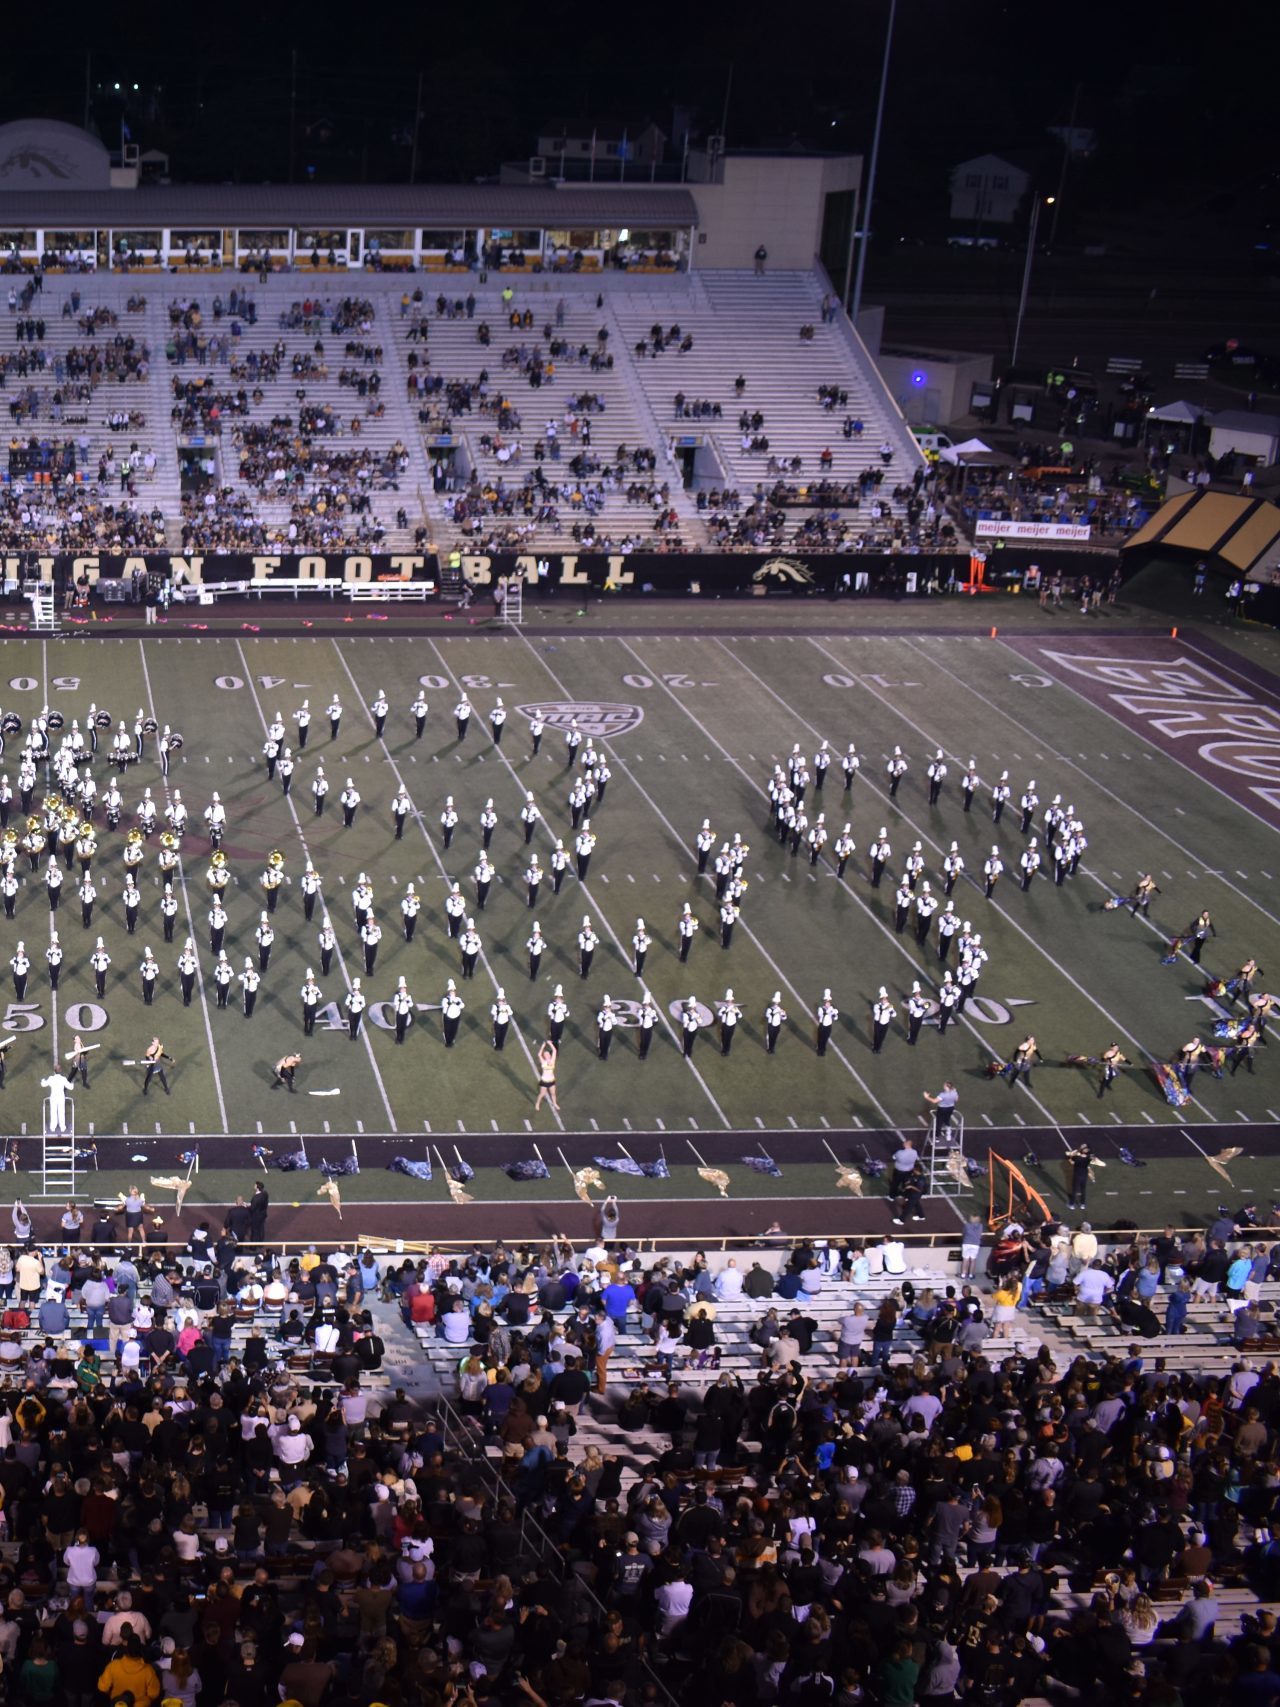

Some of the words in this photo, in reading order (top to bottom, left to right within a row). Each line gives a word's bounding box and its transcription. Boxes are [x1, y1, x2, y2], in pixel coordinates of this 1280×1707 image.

[977, 522, 1012, 534] meijer
[1016, 523, 1050, 536] meijer
[1056, 525, 1088, 537] meijer
[9, 676, 81, 691] 50
[214, 675, 286, 690] 40
[418, 674, 492, 690] 30
[622, 674, 696, 689] 20
[1, 1002, 108, 1032] 50
